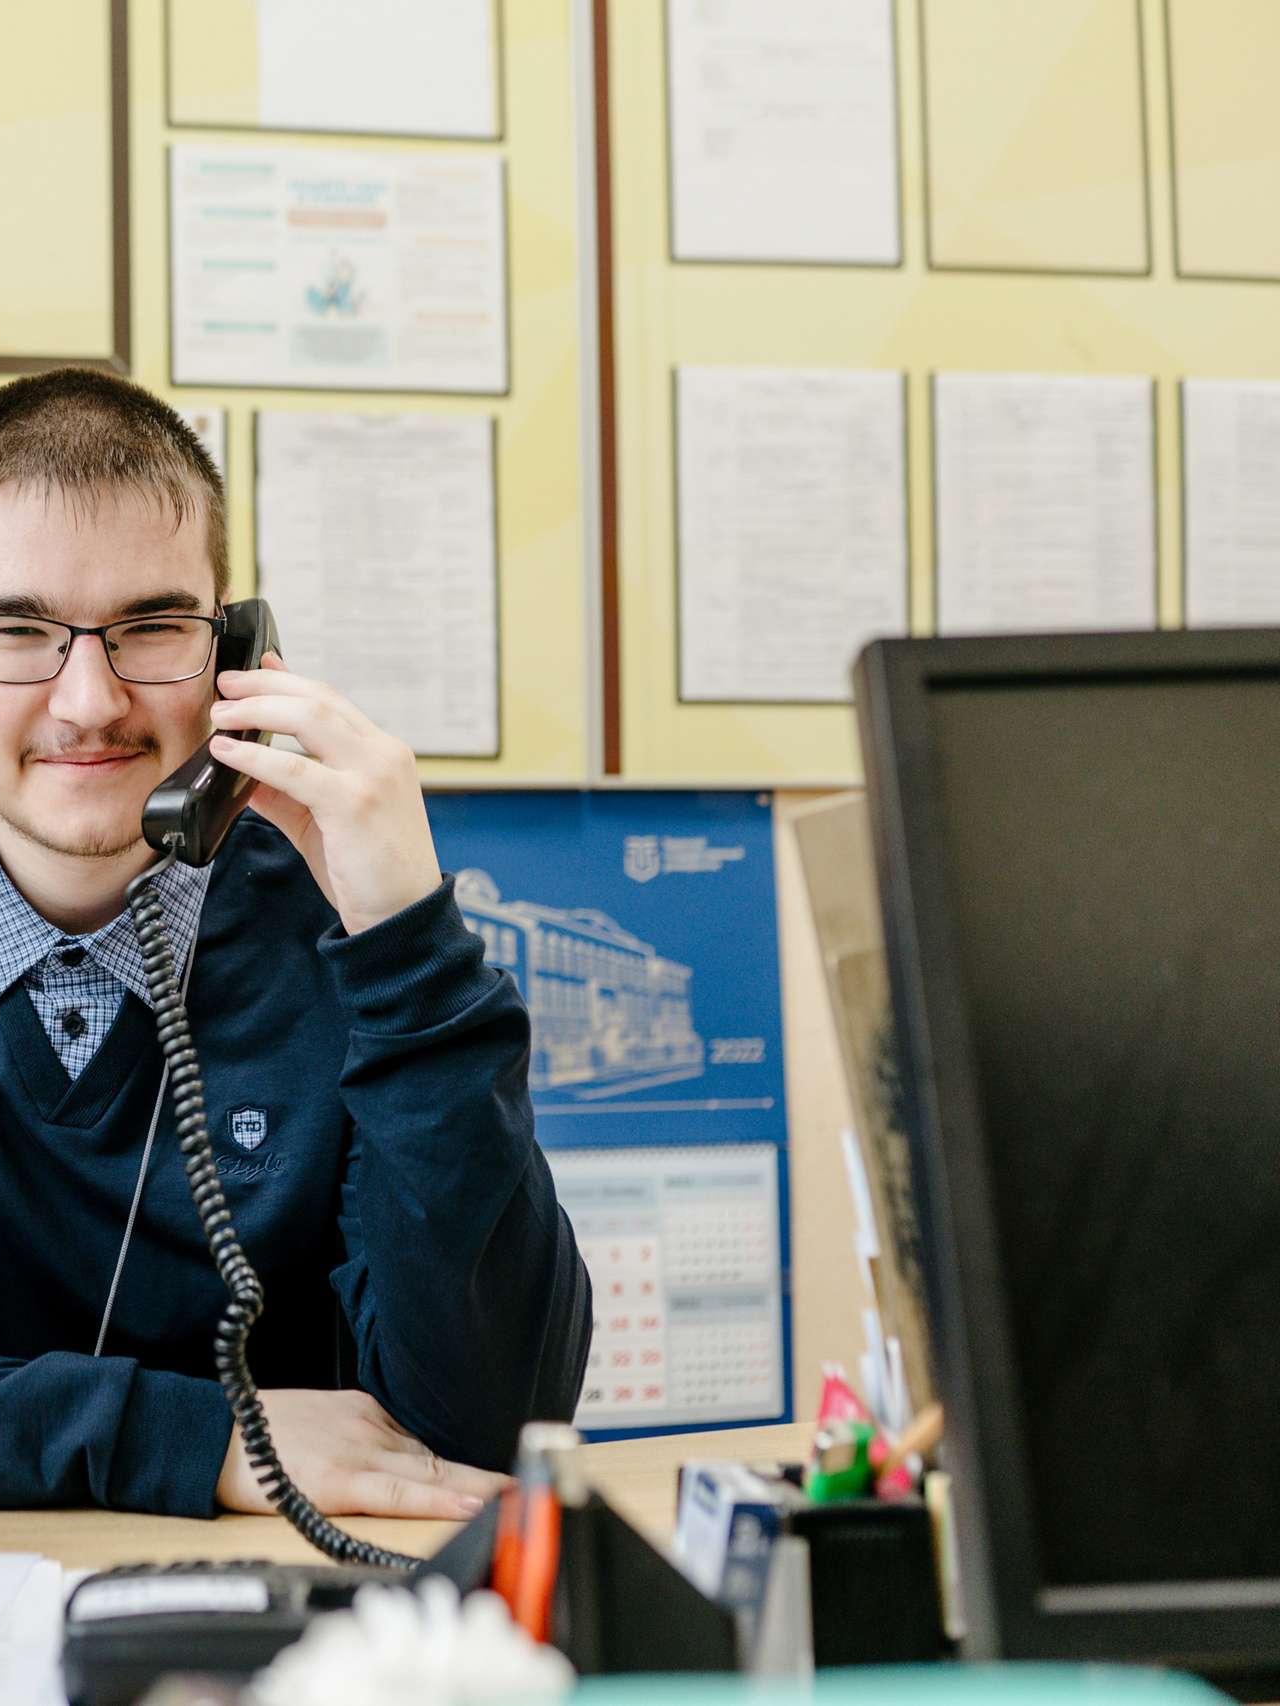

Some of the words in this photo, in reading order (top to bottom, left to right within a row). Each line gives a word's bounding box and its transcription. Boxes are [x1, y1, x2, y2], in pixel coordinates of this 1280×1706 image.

[709, 1037, 766, 1064] 2022
[235, 1122, 261, 1133] ETD
[215, 1153, 283, 1181] Style
